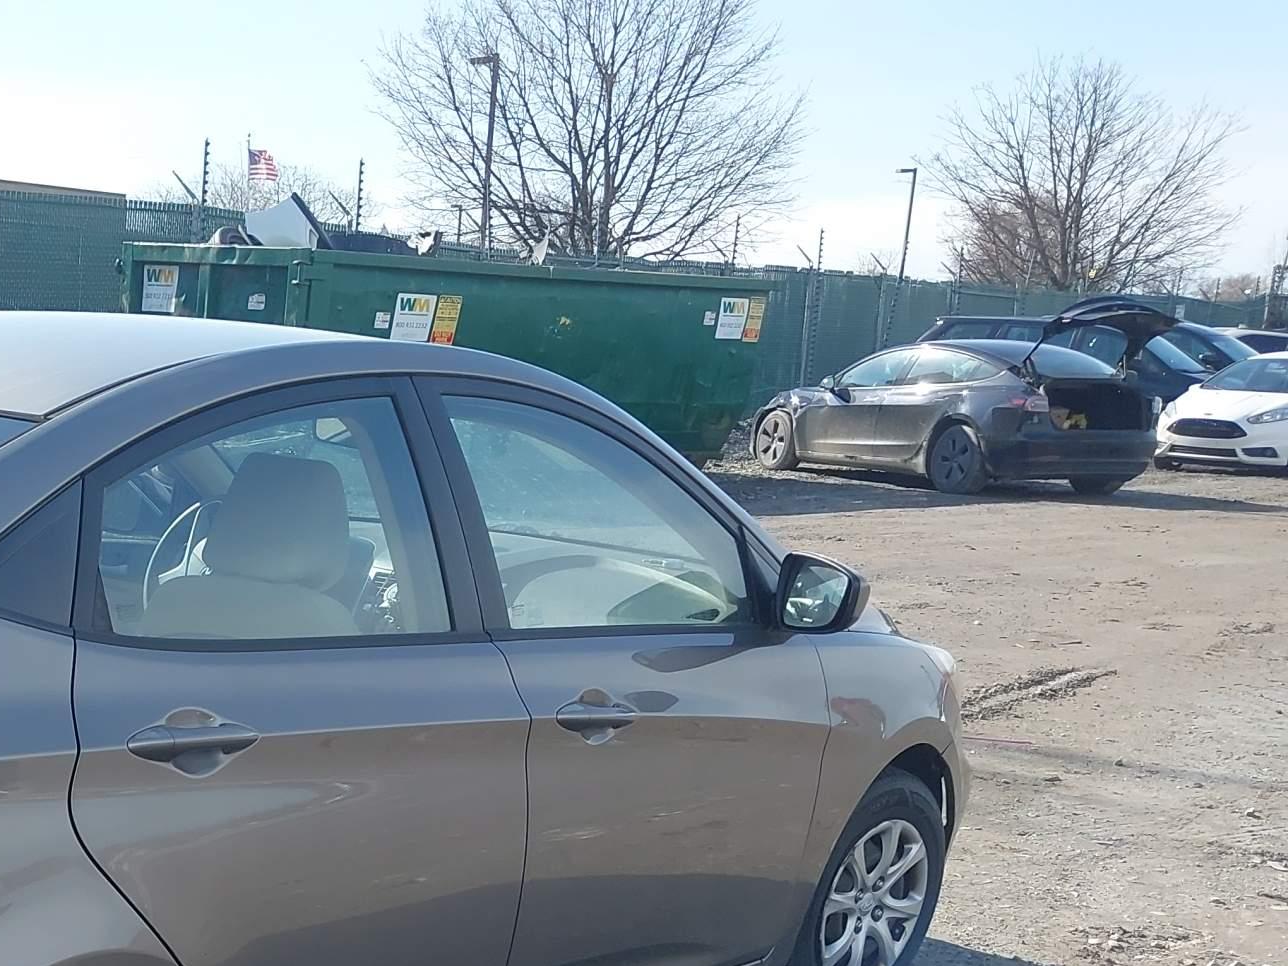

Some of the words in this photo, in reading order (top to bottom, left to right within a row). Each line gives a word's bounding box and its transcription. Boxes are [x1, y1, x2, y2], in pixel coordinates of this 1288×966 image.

[147, 269, 175, 283] WM
[400, 297, 430, 312] WM
[723, 301, 745, 314] WM
